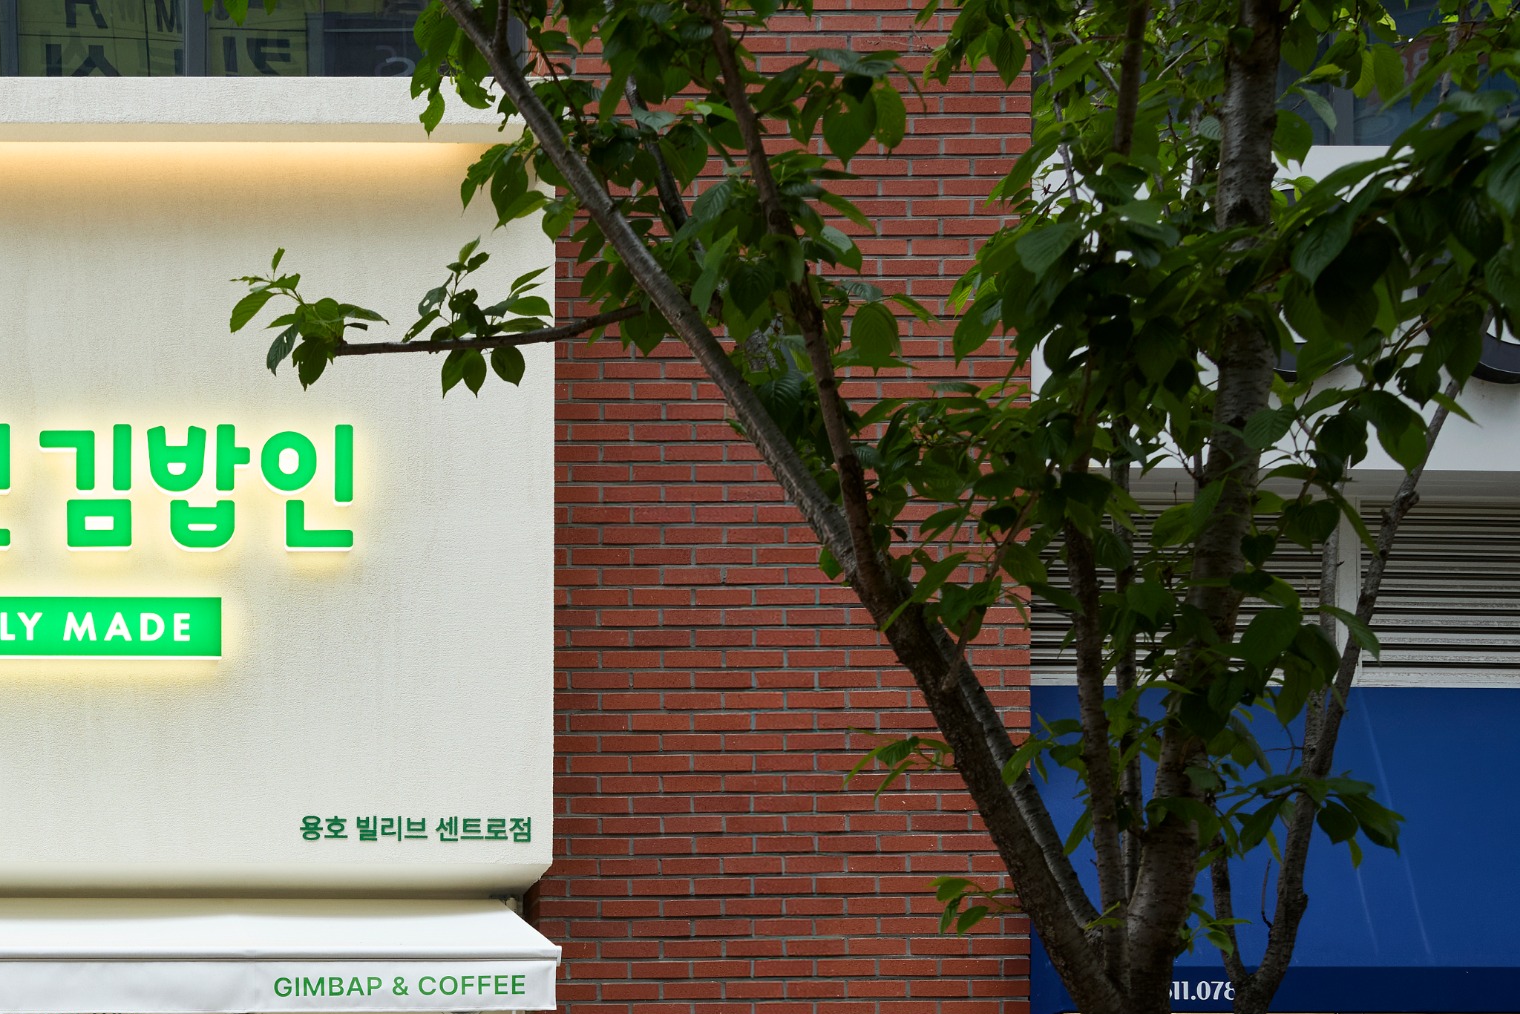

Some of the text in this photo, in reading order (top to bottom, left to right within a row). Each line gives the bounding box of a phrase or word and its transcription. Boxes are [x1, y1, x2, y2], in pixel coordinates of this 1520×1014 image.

[38, 423, 354, 550] 김밥인
[62, 611, 192, 642] MADE
[299, 815, 532, 843] 용호 빌리브 센트로점
[273, 974, 526, 998] GIMBAP & COFFEE
[1169, 981, 1236, 1001] 11.078
